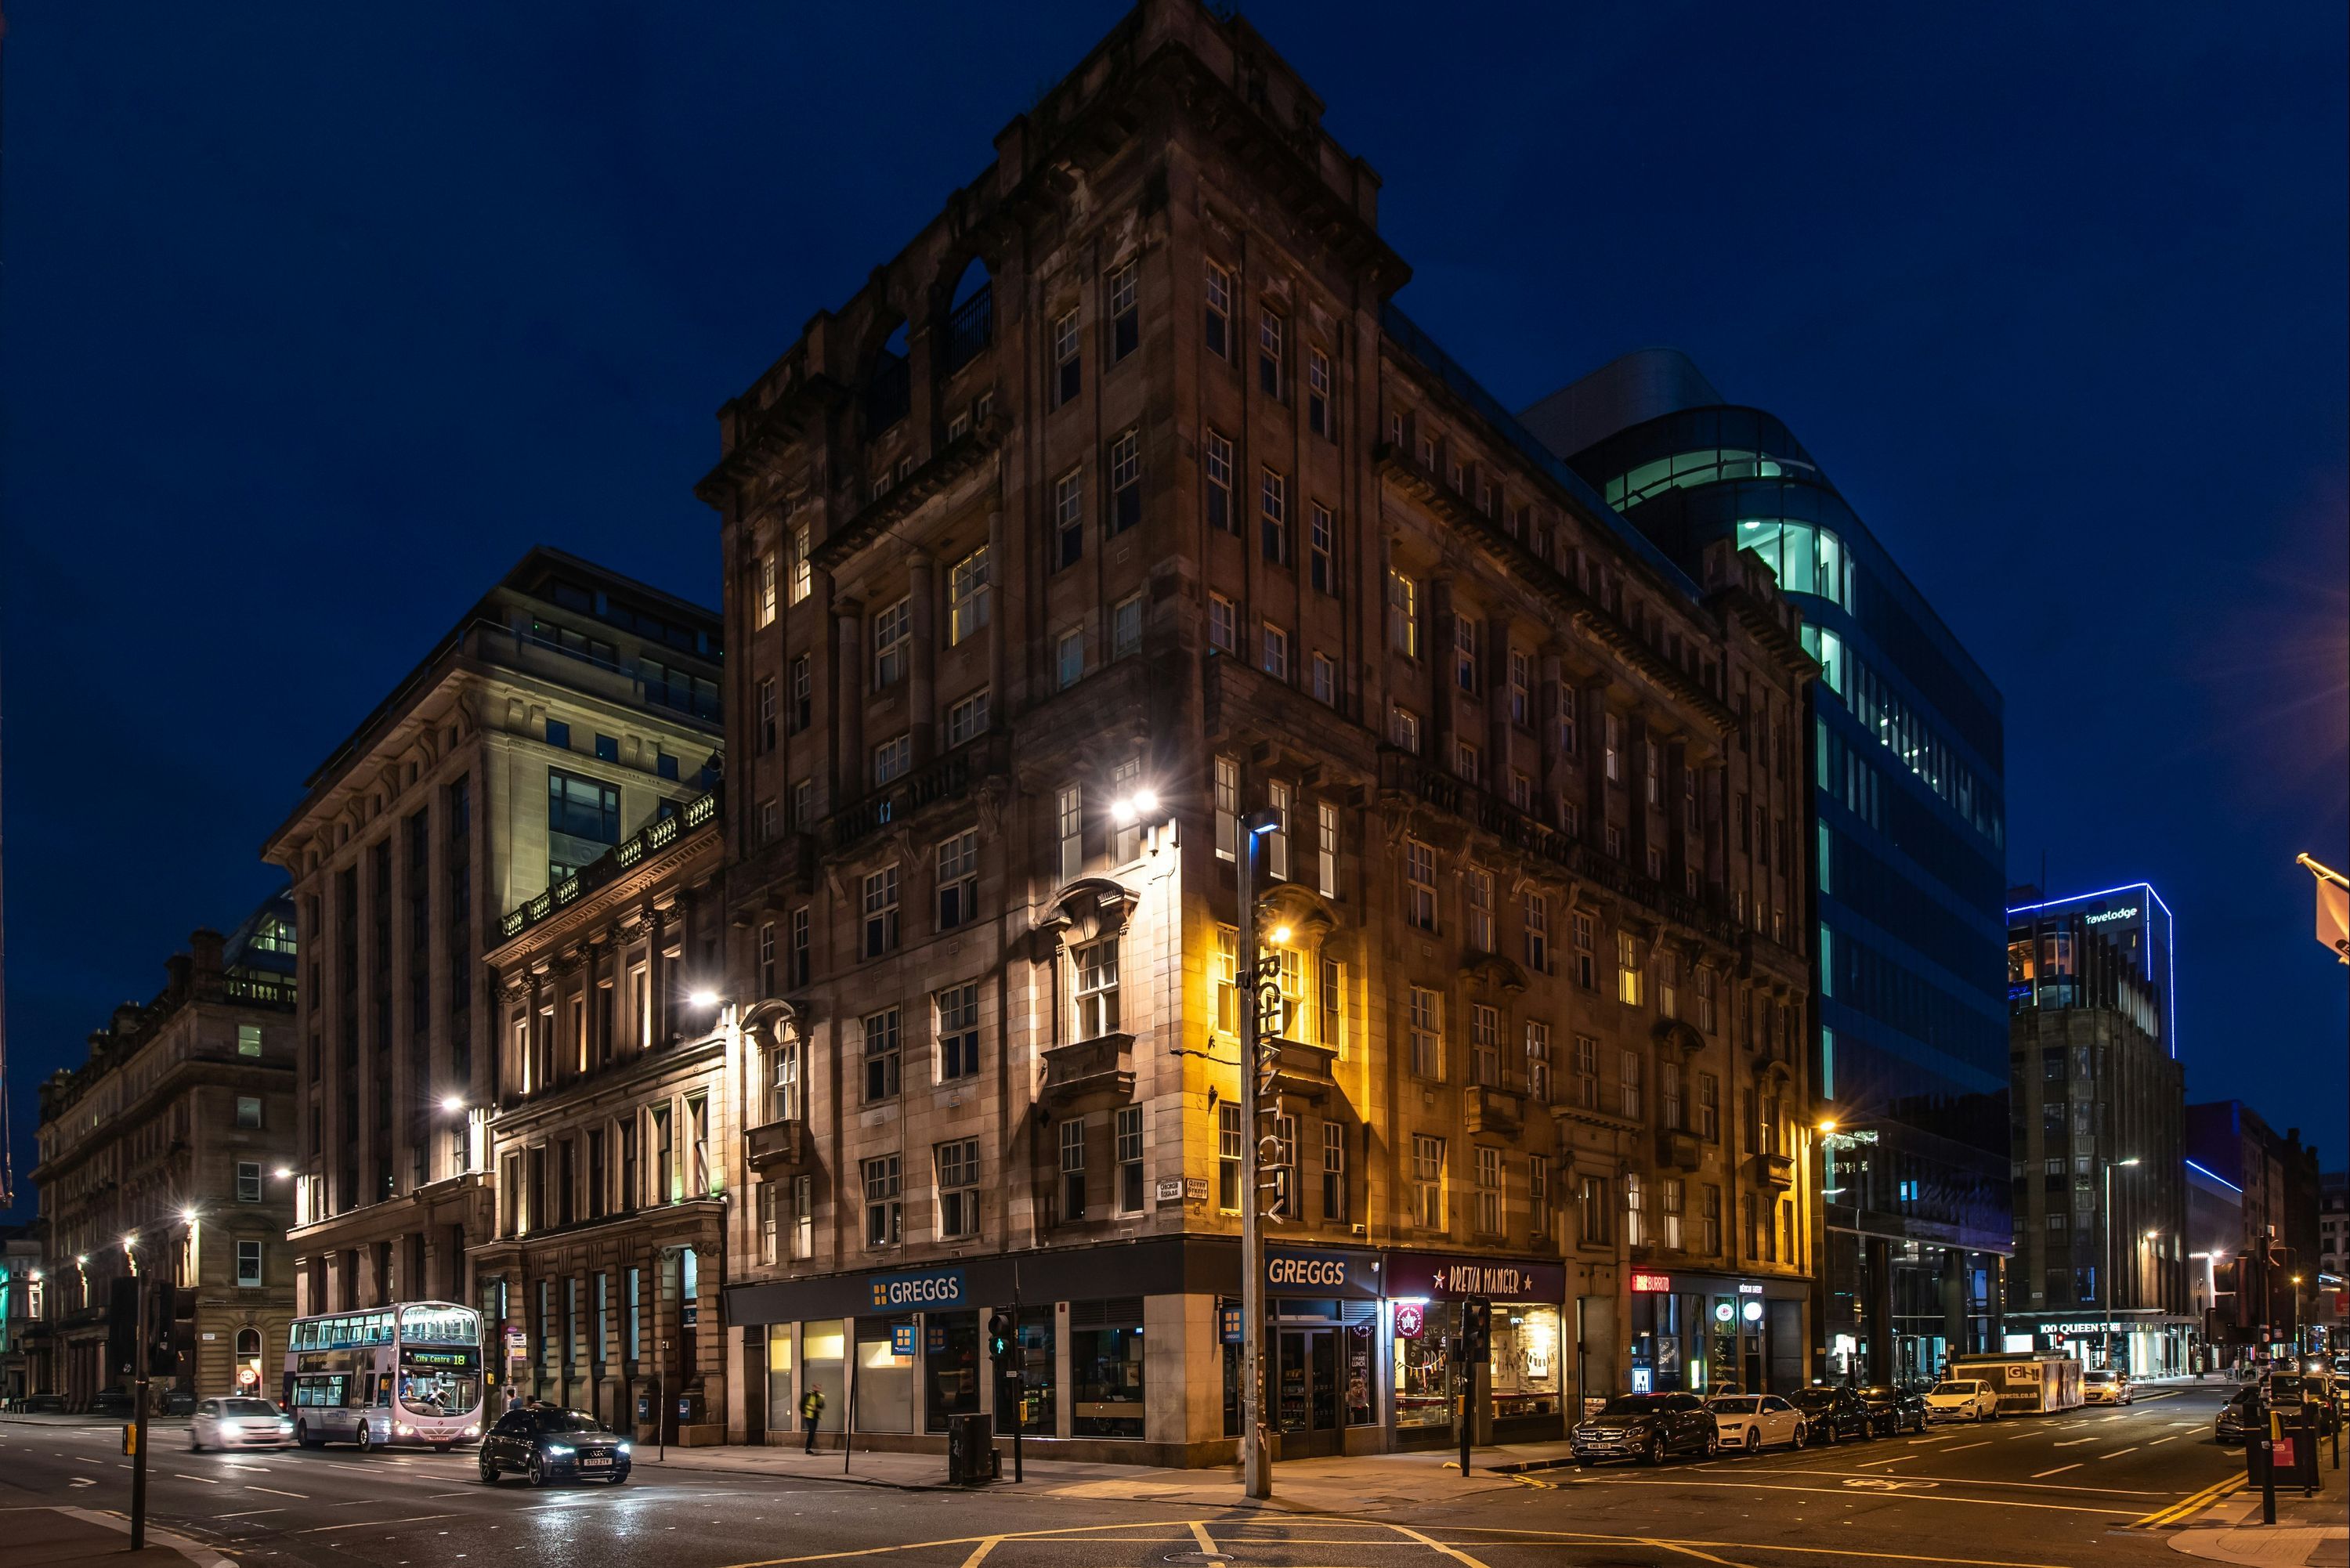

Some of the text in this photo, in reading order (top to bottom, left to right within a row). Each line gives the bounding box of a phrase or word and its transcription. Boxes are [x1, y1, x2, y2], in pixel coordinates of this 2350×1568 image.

[2085, 908, 2138, 924] Travelodge
[1256, 1135, 1284, 1225] CITY
[1188, 1187, 1207, 1195] STREET
[1269, 1258, 1345, 1285] GREGGS
[1483, 1268, 1519, 1294] MANGER
[890, 1277, 959, 1303] GREGGS
[2041, 1324, 2058, 1333] 100
[2059, 1323, 2099, 1335] QUEEN
[454, 1355, 465, 1364] 18
